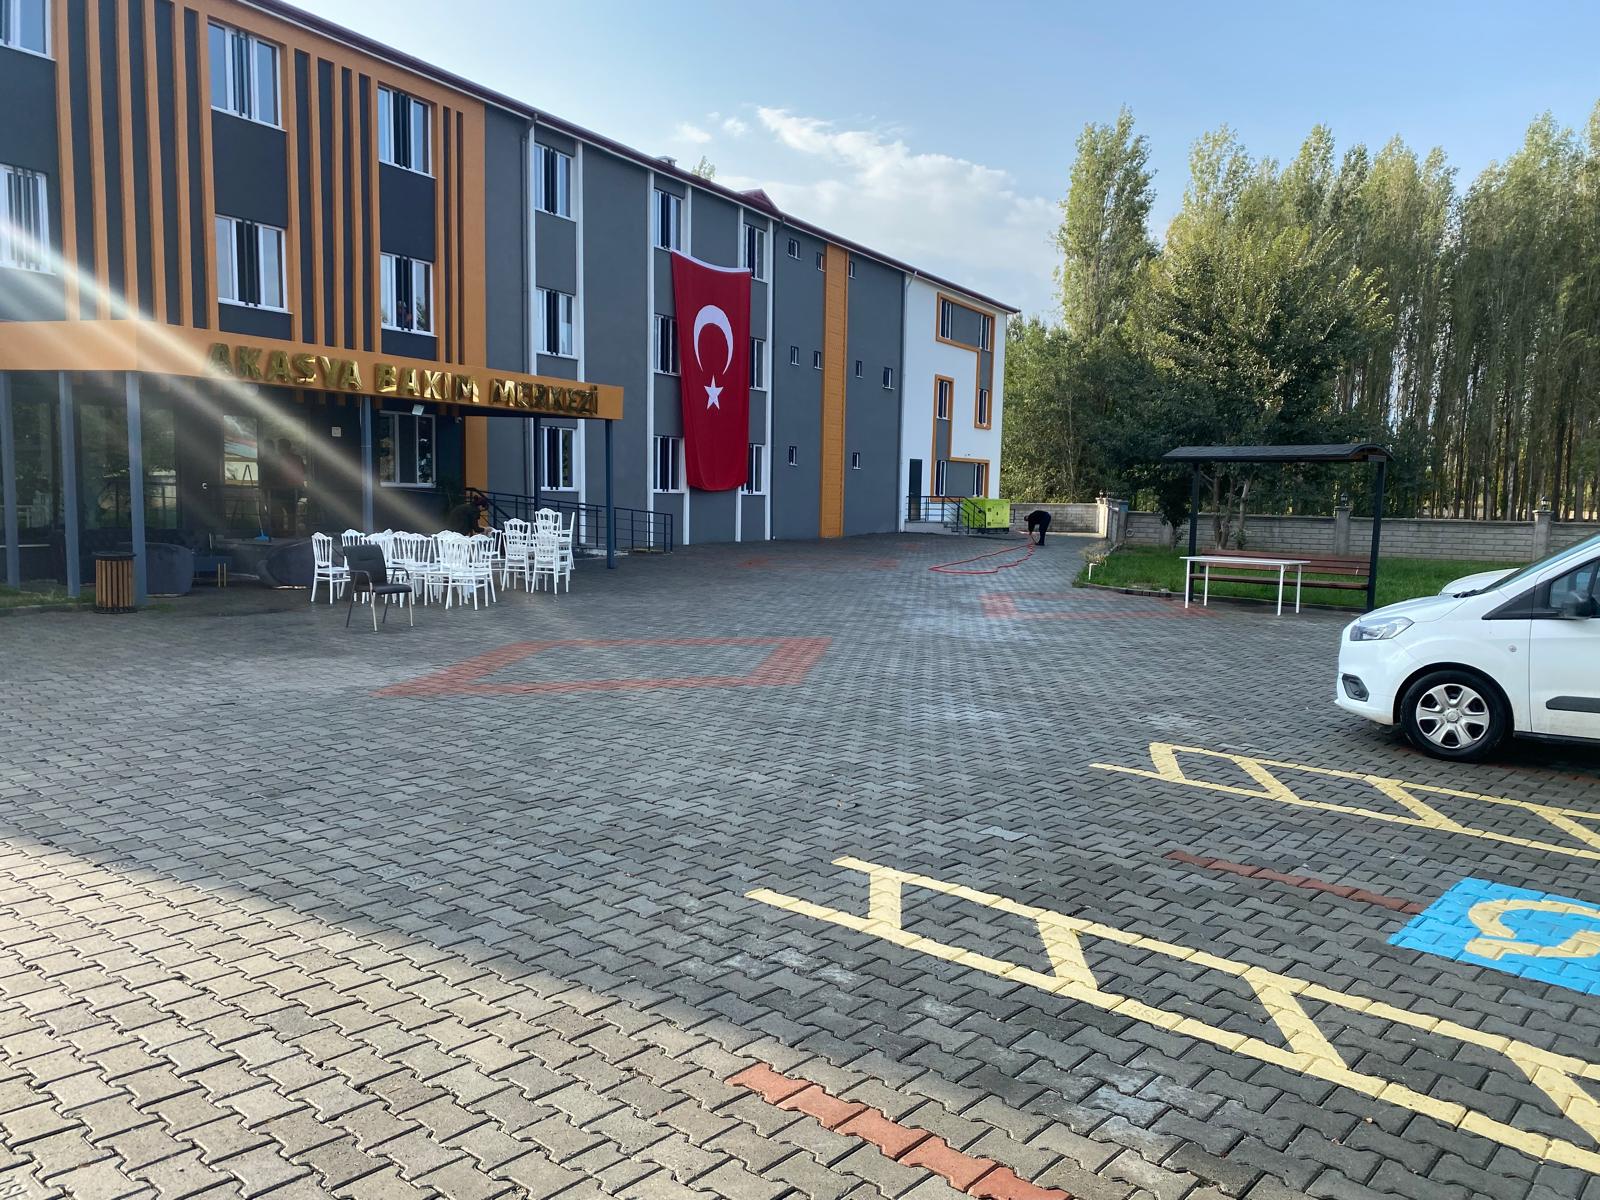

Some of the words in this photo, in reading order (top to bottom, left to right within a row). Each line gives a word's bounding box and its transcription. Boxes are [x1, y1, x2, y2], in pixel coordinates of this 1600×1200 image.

[208, 342, 363, 390] AKASYA
[375, 362, 479, 403] BAKIM
[491, 377, 599, 415] MERKEZİ
